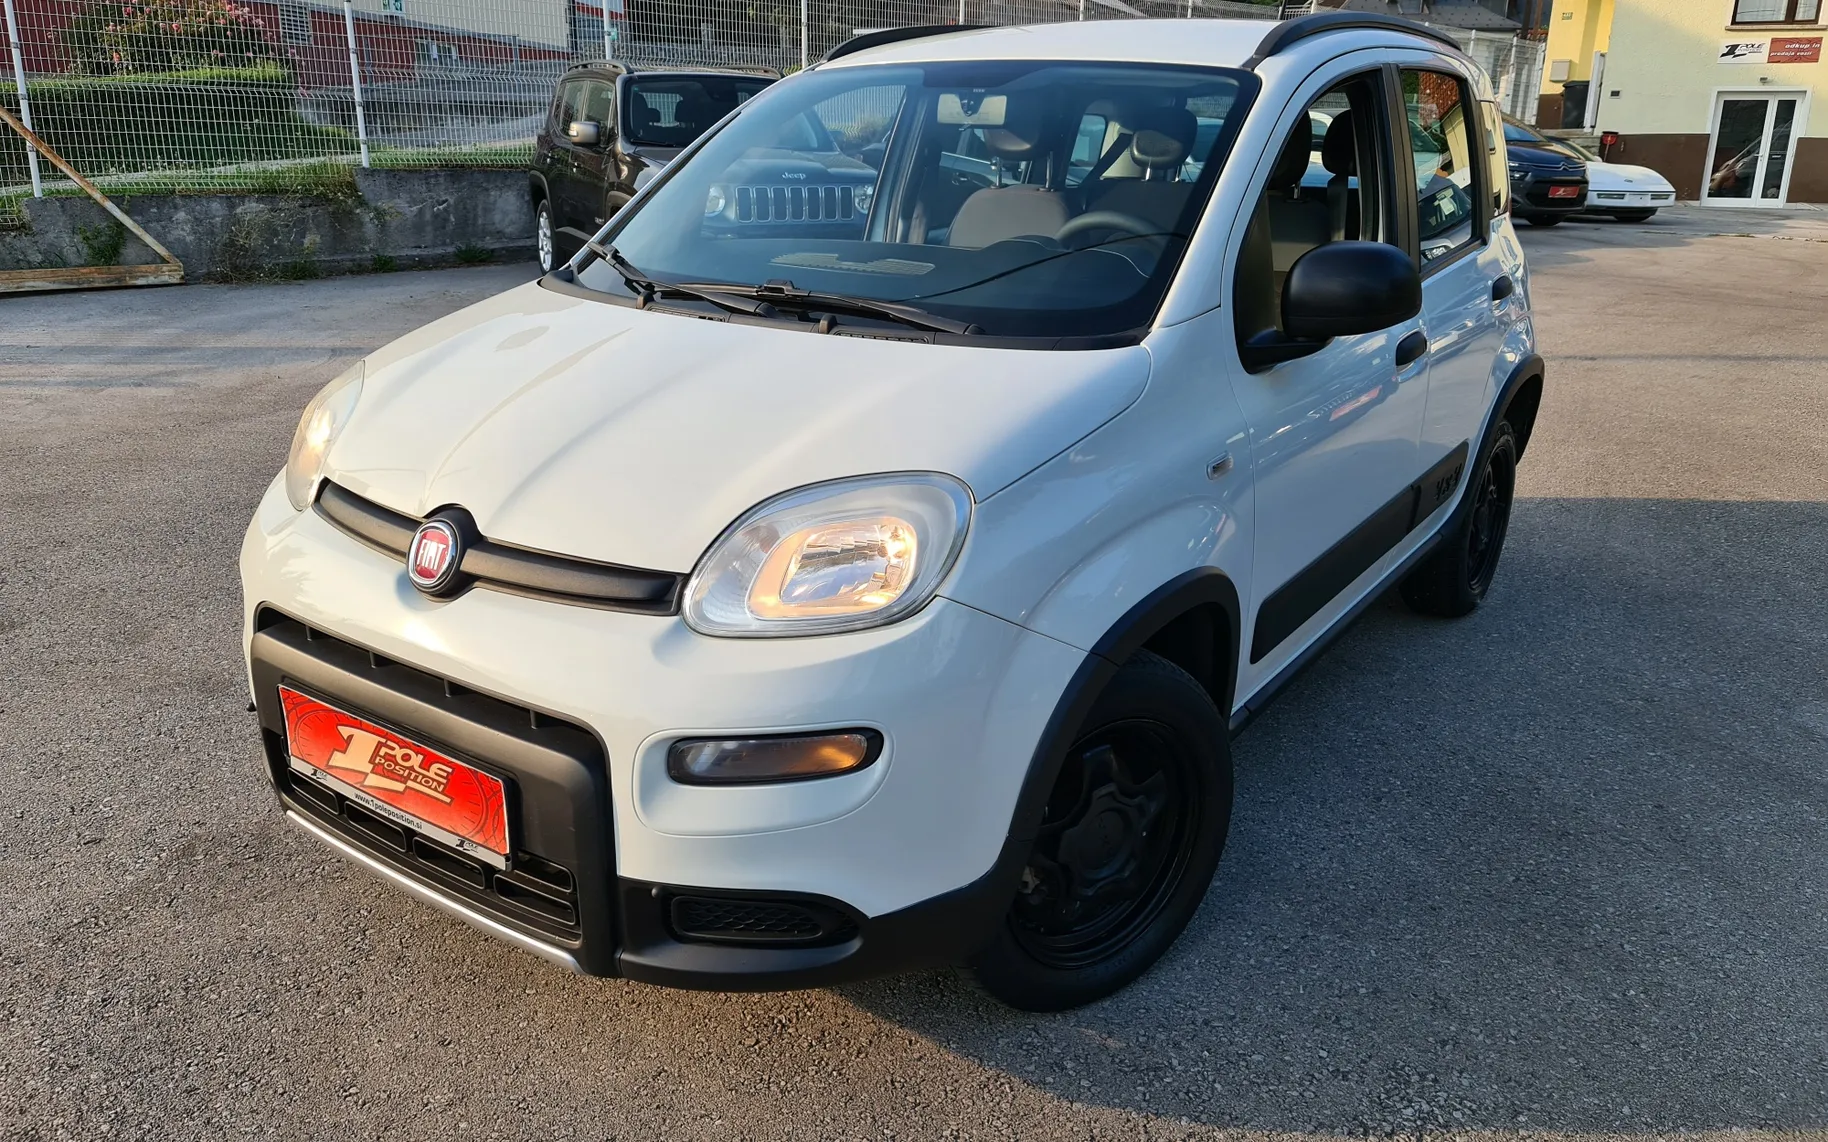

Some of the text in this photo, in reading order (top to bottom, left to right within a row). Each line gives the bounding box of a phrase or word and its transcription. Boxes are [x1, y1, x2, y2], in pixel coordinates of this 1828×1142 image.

[781, 171, 807, 180] Jeep
[417, 539, 447, 570] FIAT
[375, 756, 444, 792] POSITION
[379, 740, 453, 784] POLE
[354, 792, 423, 830] www.1poleposition.si
